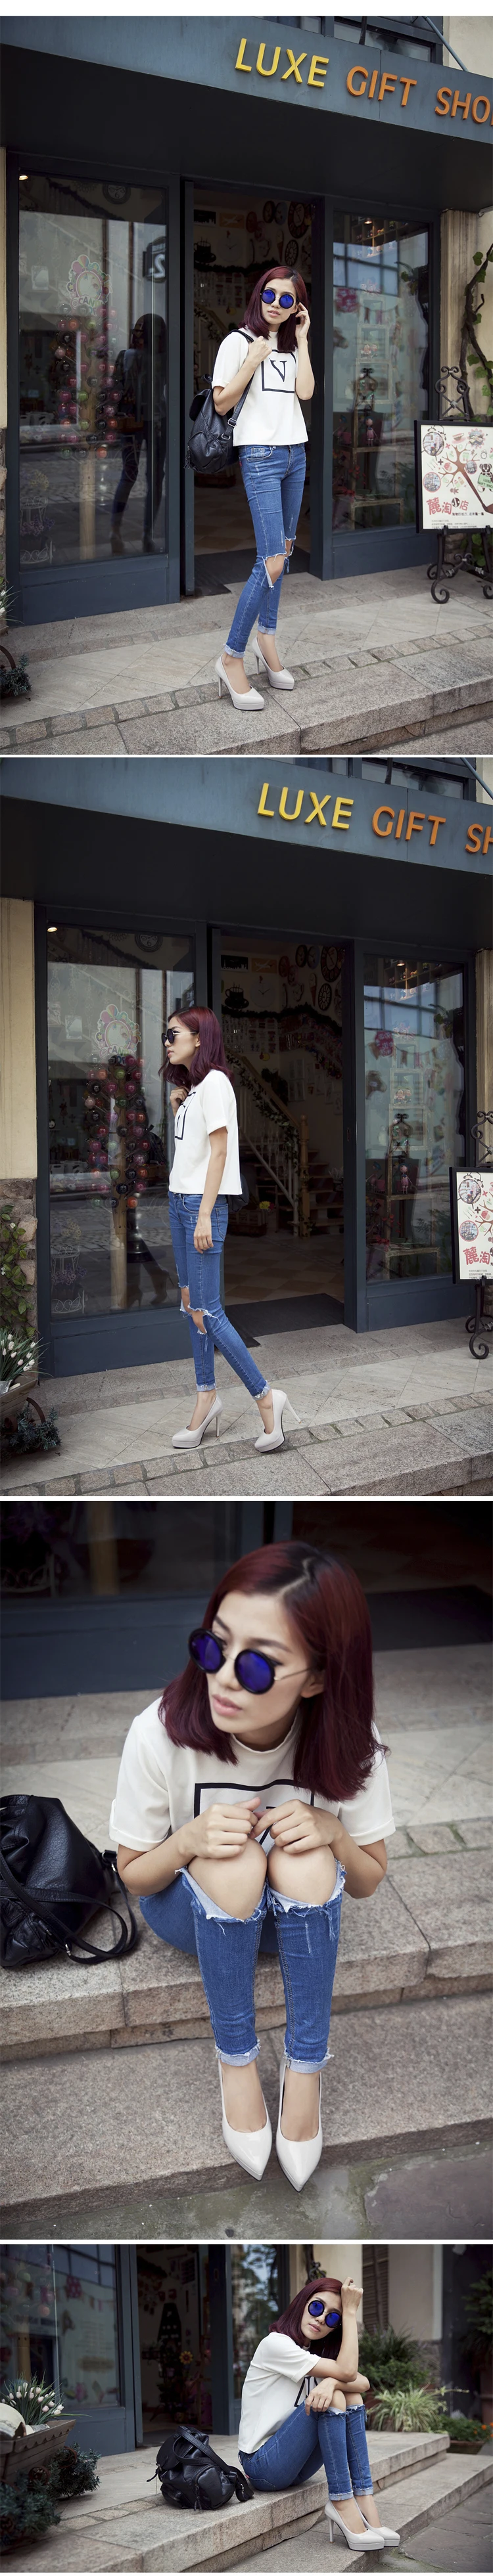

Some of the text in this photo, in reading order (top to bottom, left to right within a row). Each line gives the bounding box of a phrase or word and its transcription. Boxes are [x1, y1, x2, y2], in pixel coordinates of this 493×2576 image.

[235, 37, 493, 127] LUXE GIFT SHO
[78, 296, 103, 307] CAND
[257, 782, 354, 830] LUXE
[372, 806, 446, 846] GIFT
